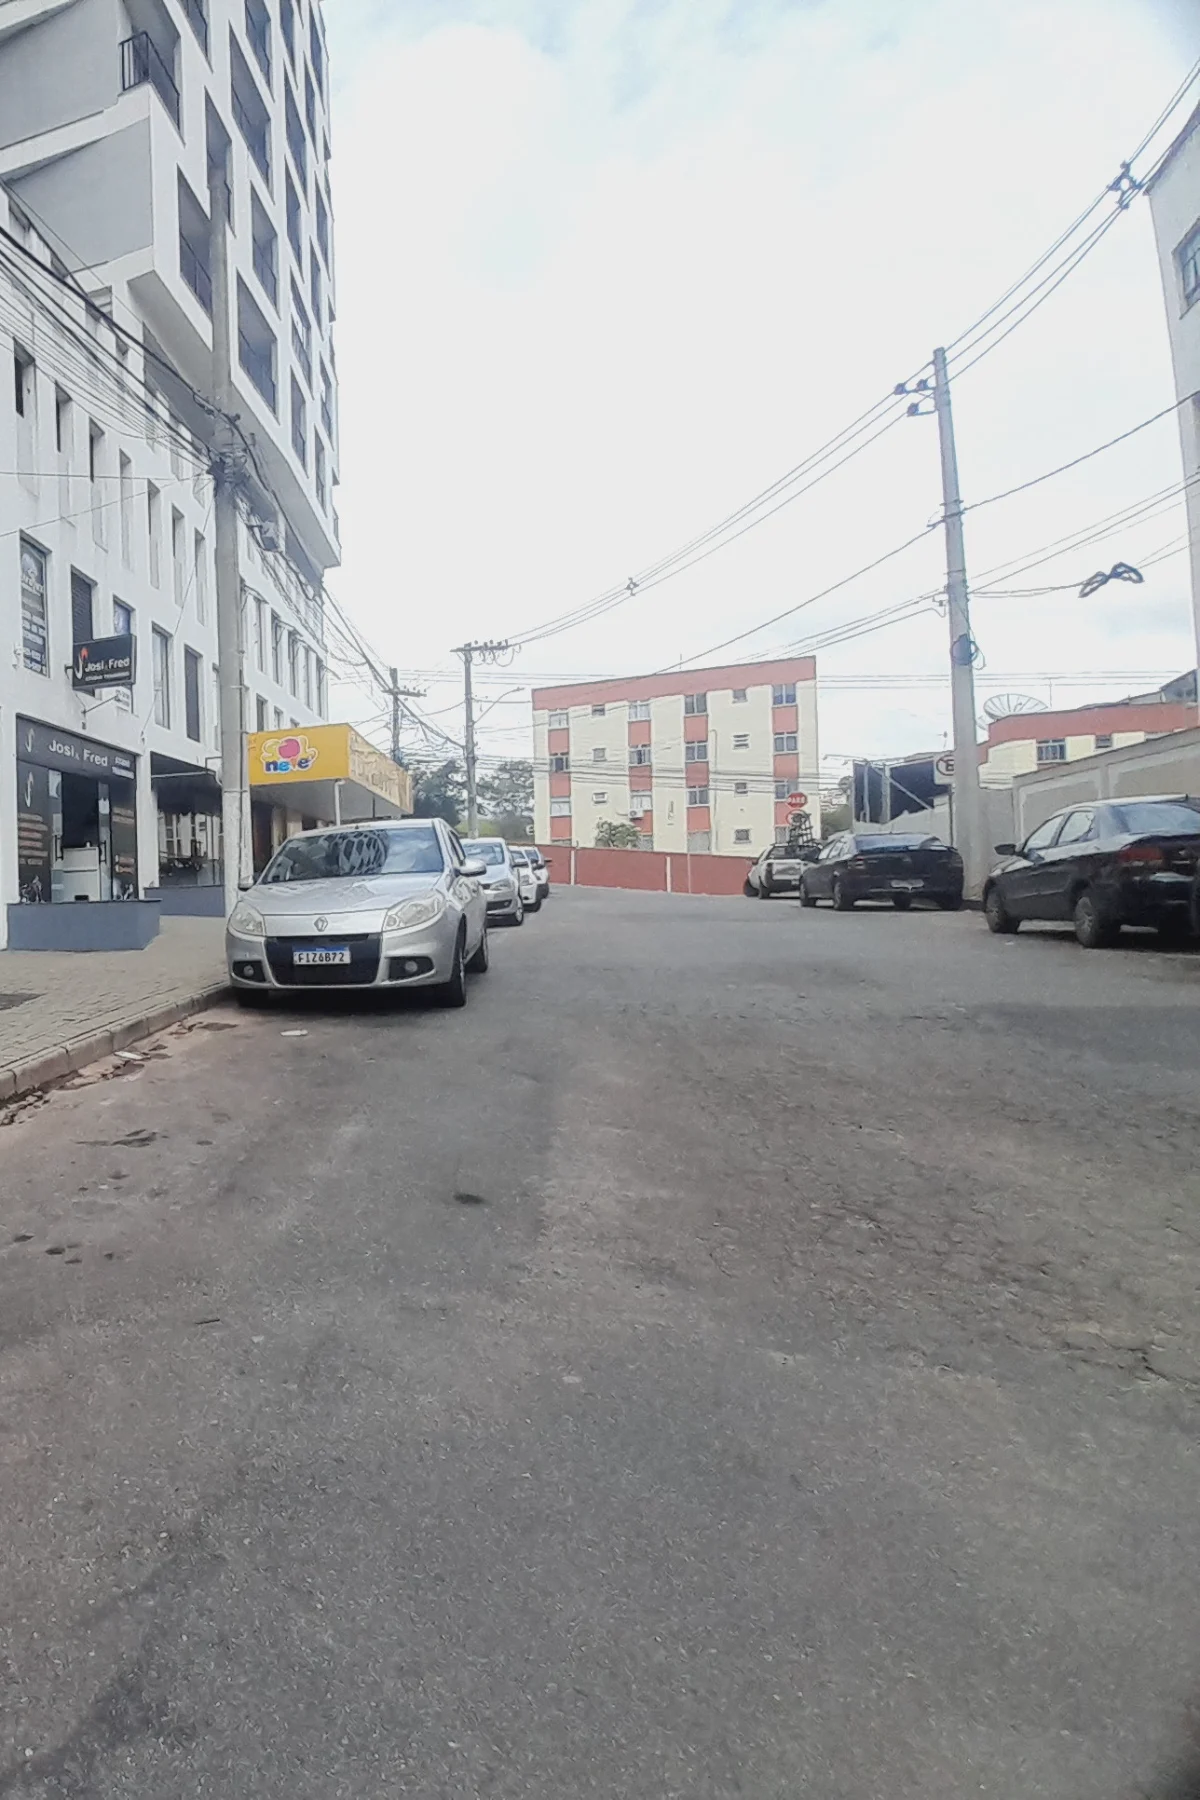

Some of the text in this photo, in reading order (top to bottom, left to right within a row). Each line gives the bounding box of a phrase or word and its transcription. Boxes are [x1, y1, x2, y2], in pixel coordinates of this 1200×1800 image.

[109, 658, 130, 669] Fred
[49, 740, 74, 757] Josi
[83, 749, 108, 767] Fred
